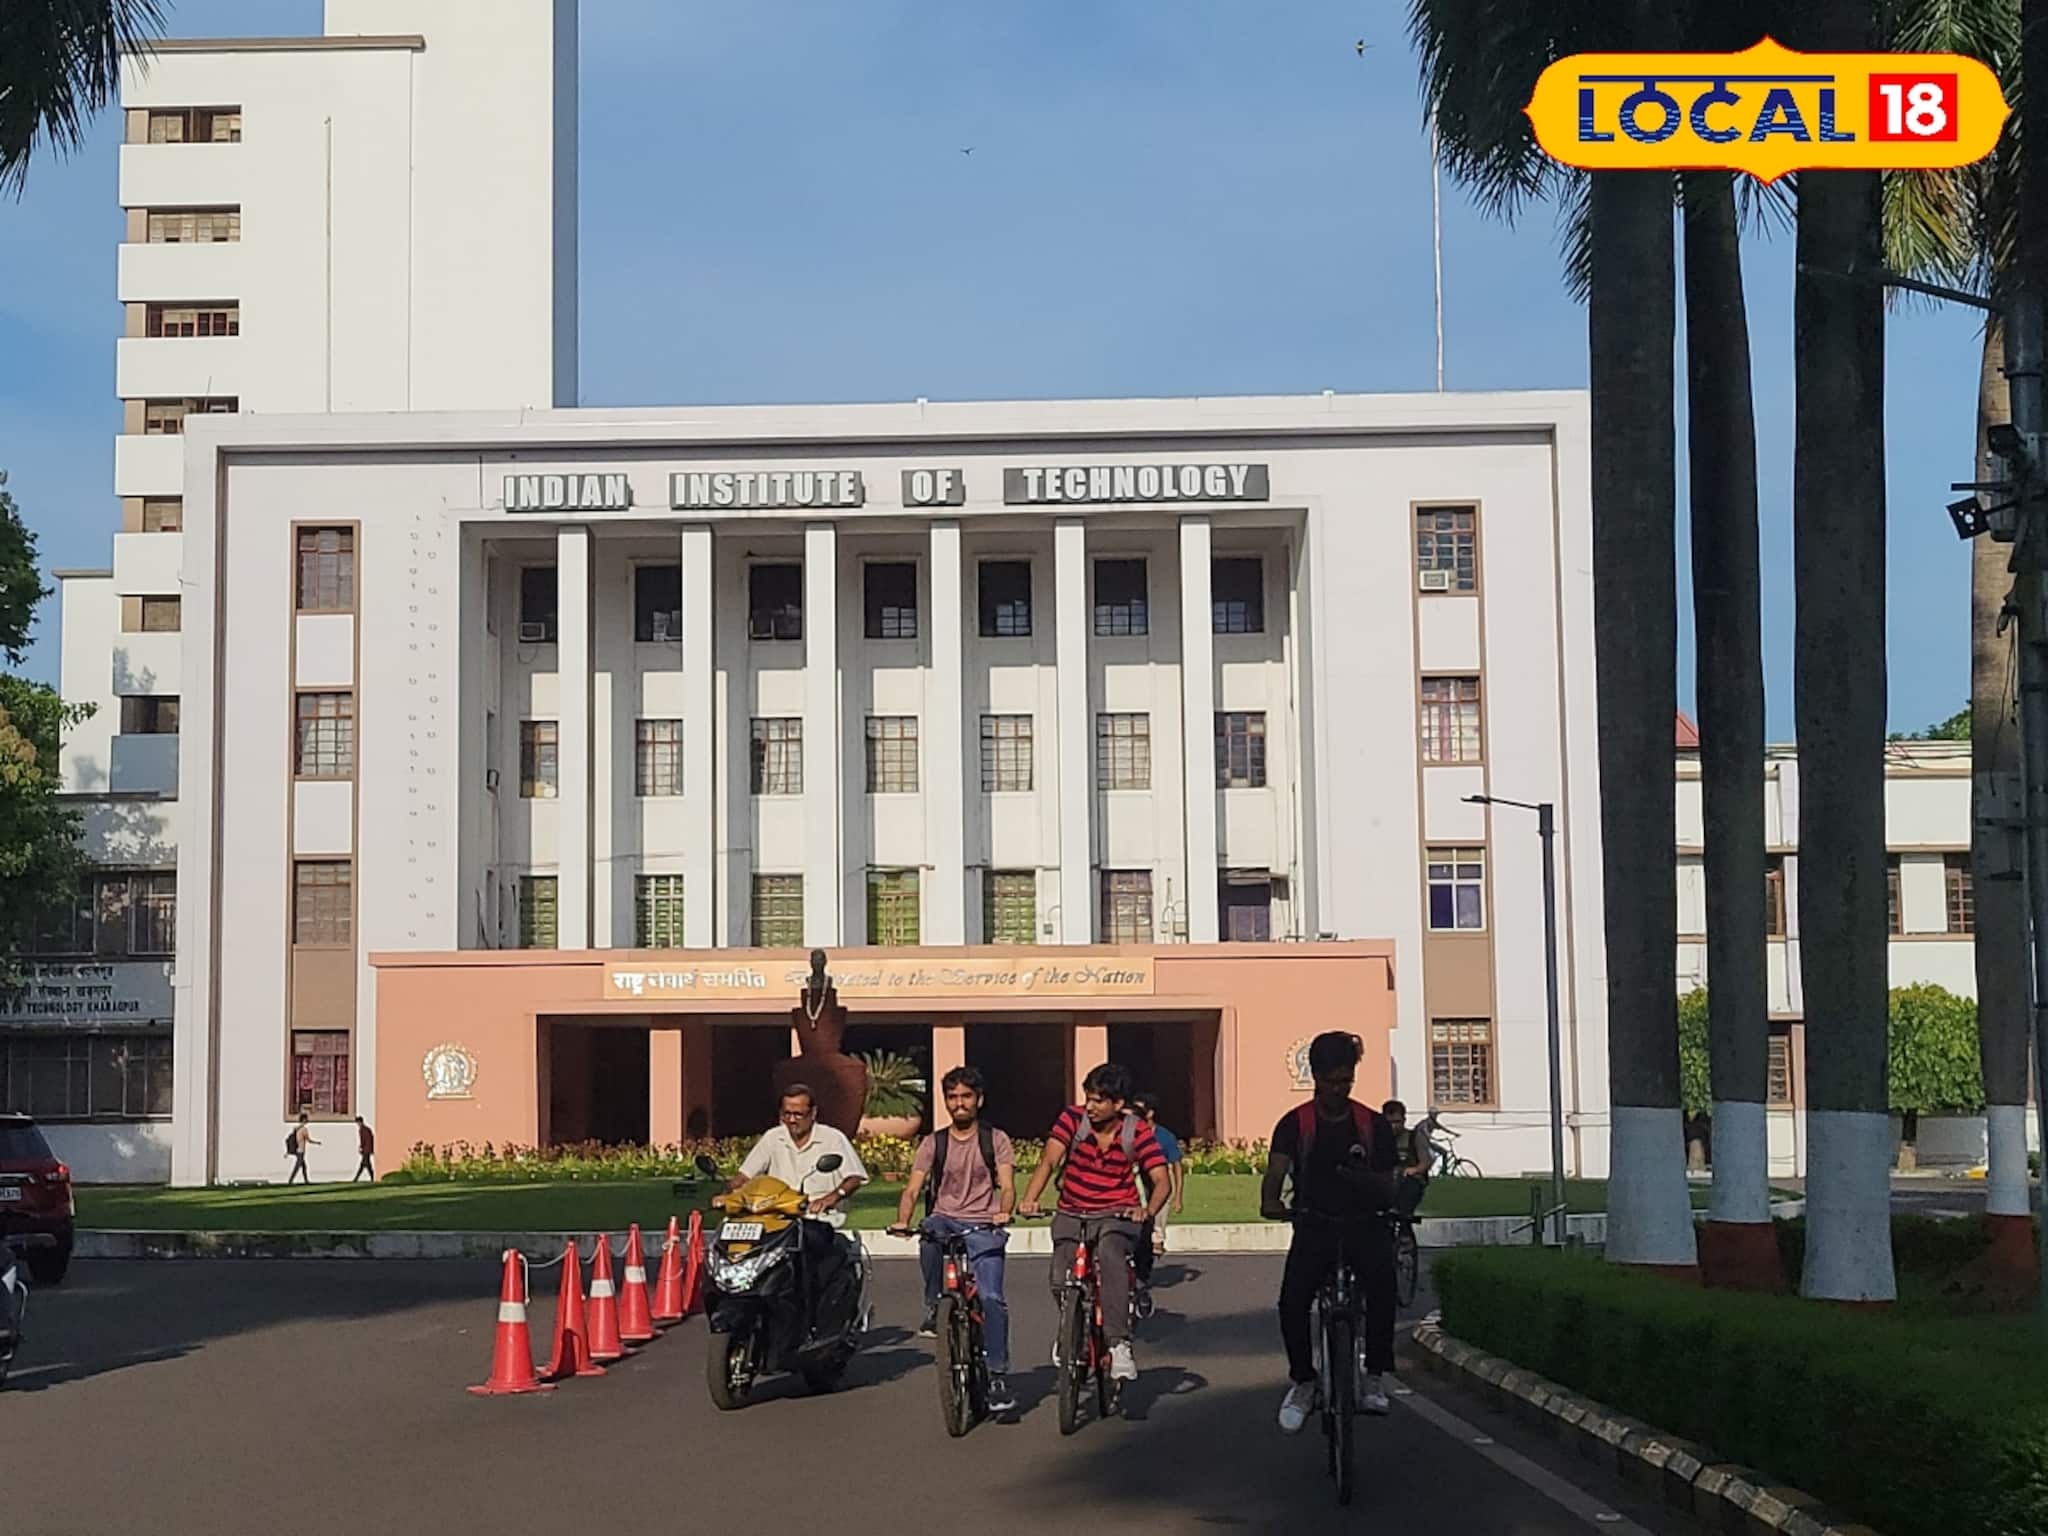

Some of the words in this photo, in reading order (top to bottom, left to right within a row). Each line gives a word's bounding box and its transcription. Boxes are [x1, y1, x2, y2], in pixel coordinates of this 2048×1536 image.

[504, 474, 629, 508] INDIAN
[674, 471, 856, 506] INSTITUTE
[910, 470, 953, 503] OF
[1022, 465, 1249, 500] TECHNOLOGY
[887, 973, 902, 986] to
[908, 969, 932, 986] the
[1021, 967, 1043, 990] of
[1043, 967, 1070, 985] the
[1075, 965, 1145, 985] Nation
[27, 1002, 84, 1013] TECHNOLOGY
